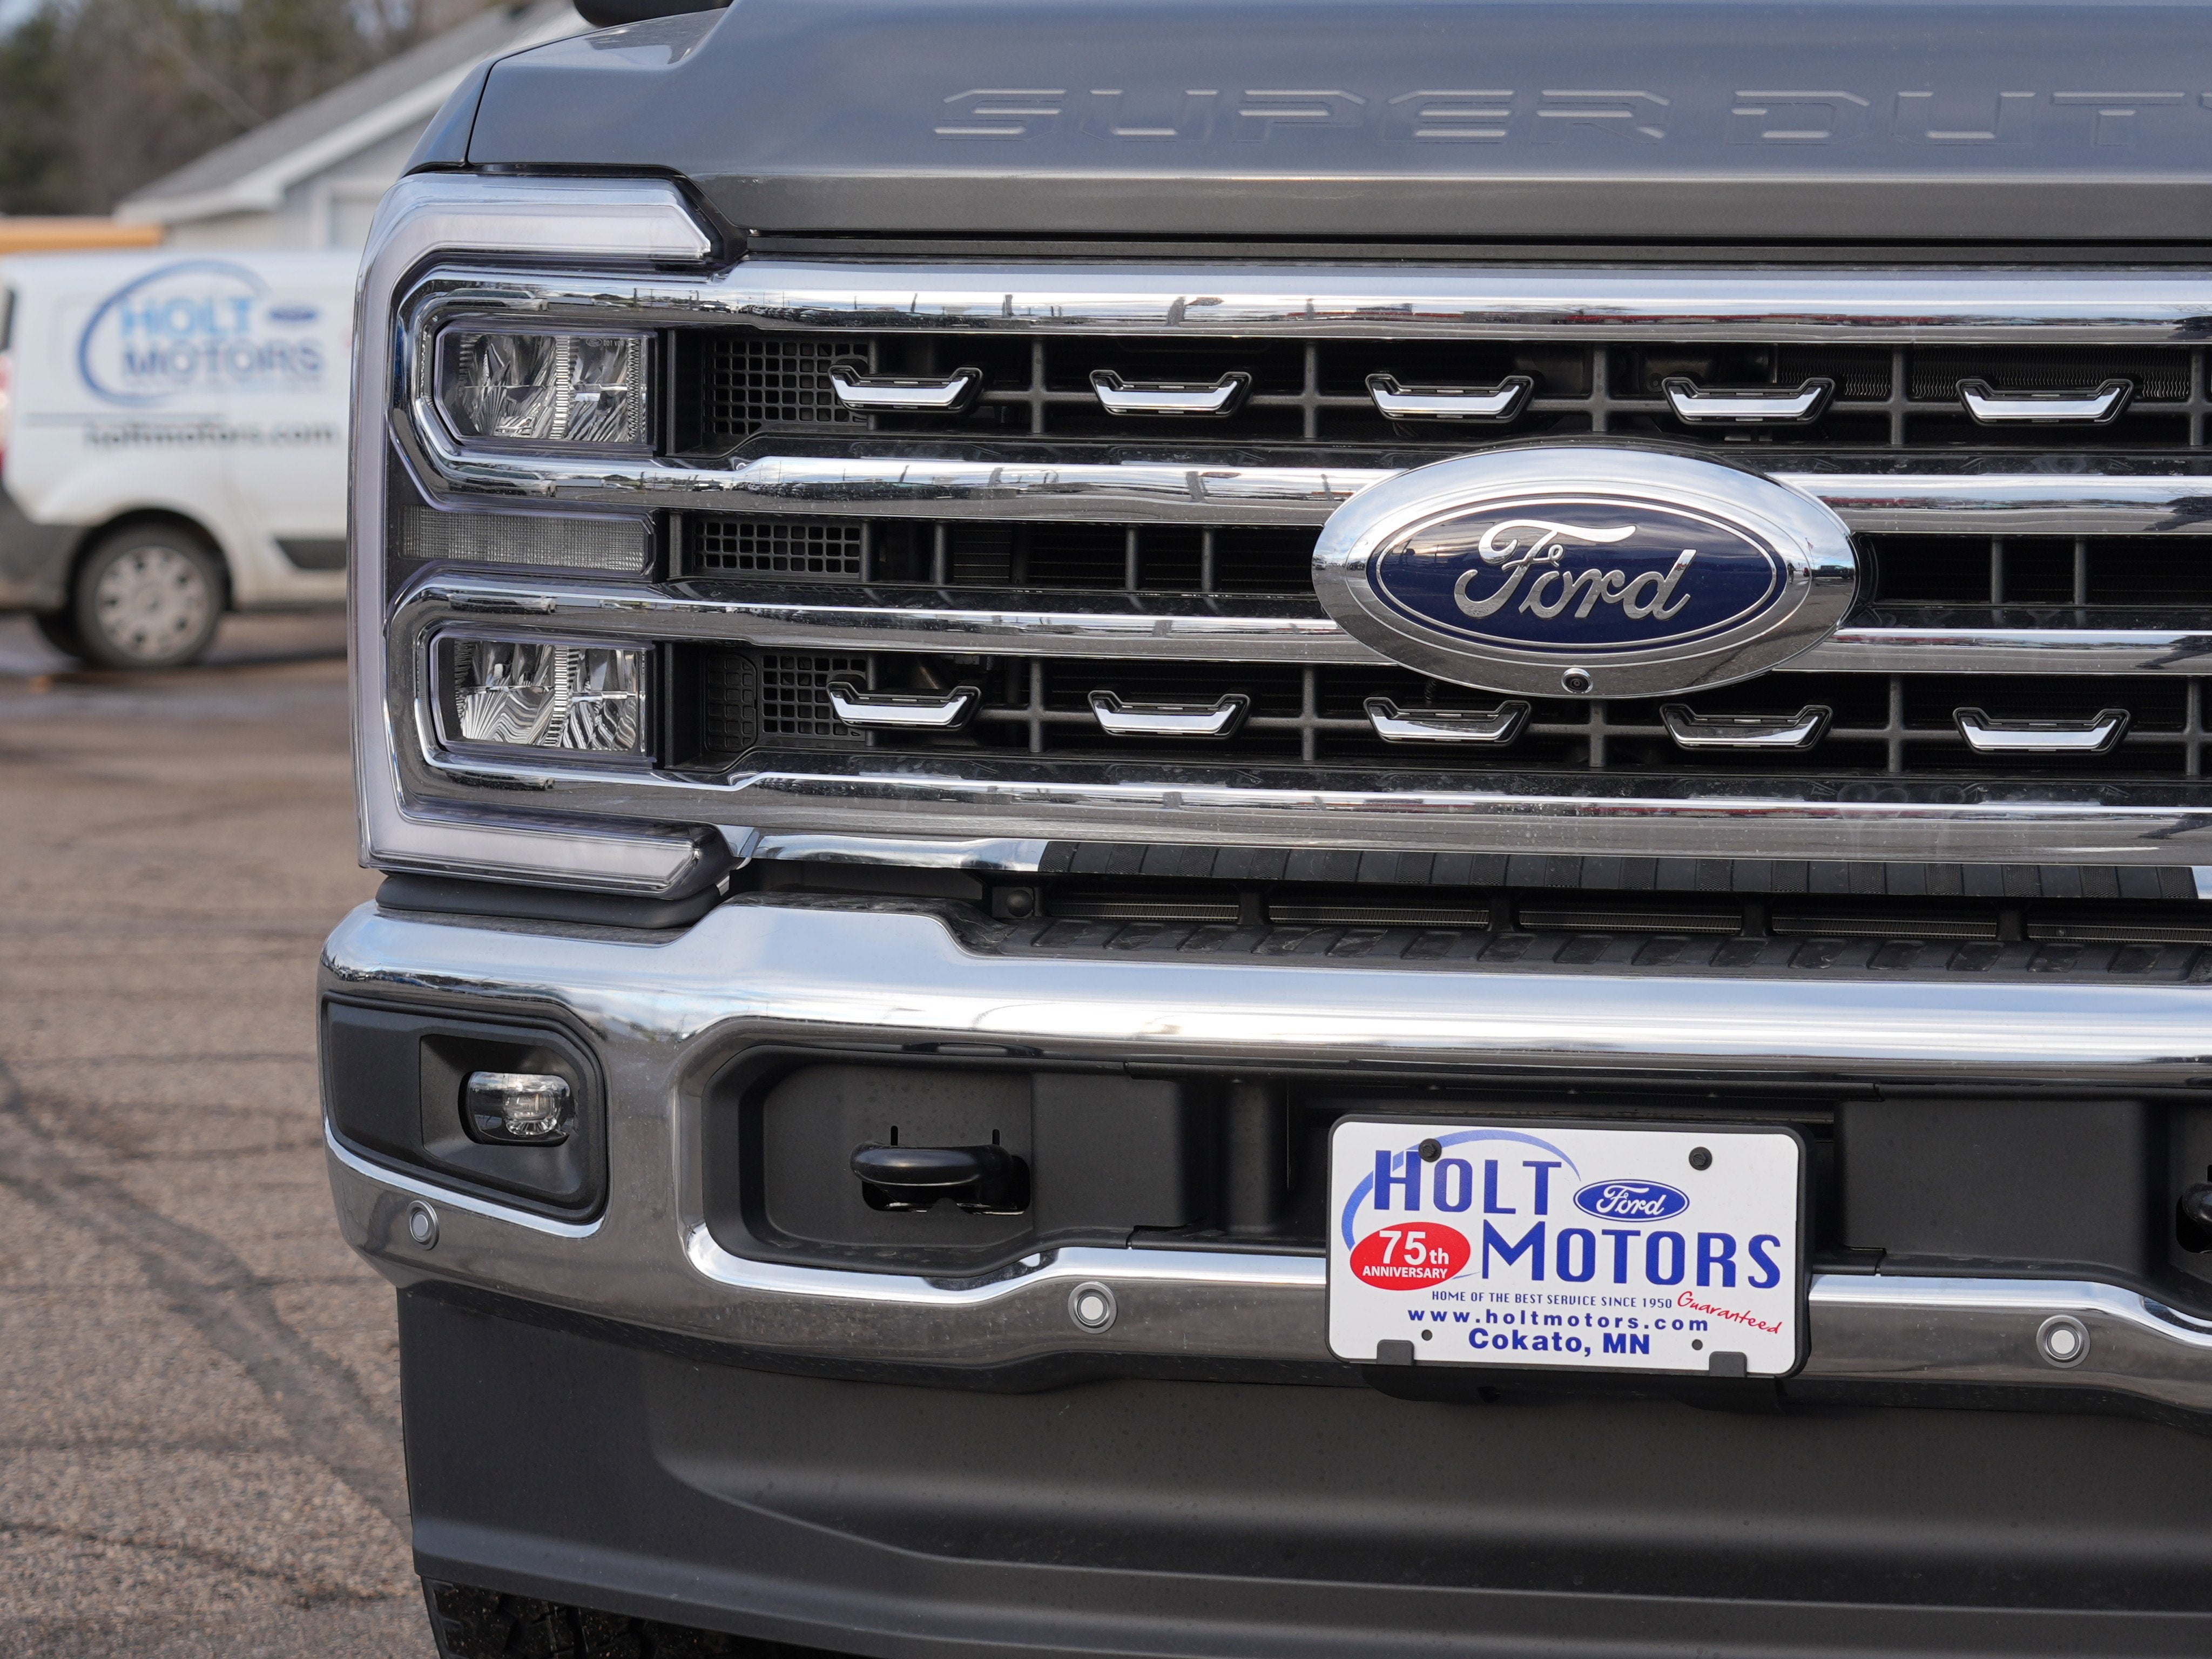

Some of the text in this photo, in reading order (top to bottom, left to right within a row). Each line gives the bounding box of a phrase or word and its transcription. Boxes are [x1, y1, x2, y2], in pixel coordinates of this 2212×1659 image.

[935, 87, 2212, 147] SUPER DUT
[120, 295, 255, 337] HOLT
[123, 339, 323, 379] MOTORS
[1454, 518, 1697, 621] Ford
[1374, 1150, 1562, 1216] HOLT
[1596, 1184, 1667, 1216] Ford
[1379, 1230, 1449, 1266] 75th
[1482, 1219, 1781, 1289] MOTORS
[1362, 1265, 1448, 1279] ANNIVERSARY
[1432, 1291, 1673, 1309] HOME OF THE BEST SERVICE SINCE 1950
[1677, 1290, 1782, 1334] Guaranteed
[1408, 1309, 1708, 1332] www.holtmotors.com
[1468, 1327, 1650, 1357] Cokato, MN
